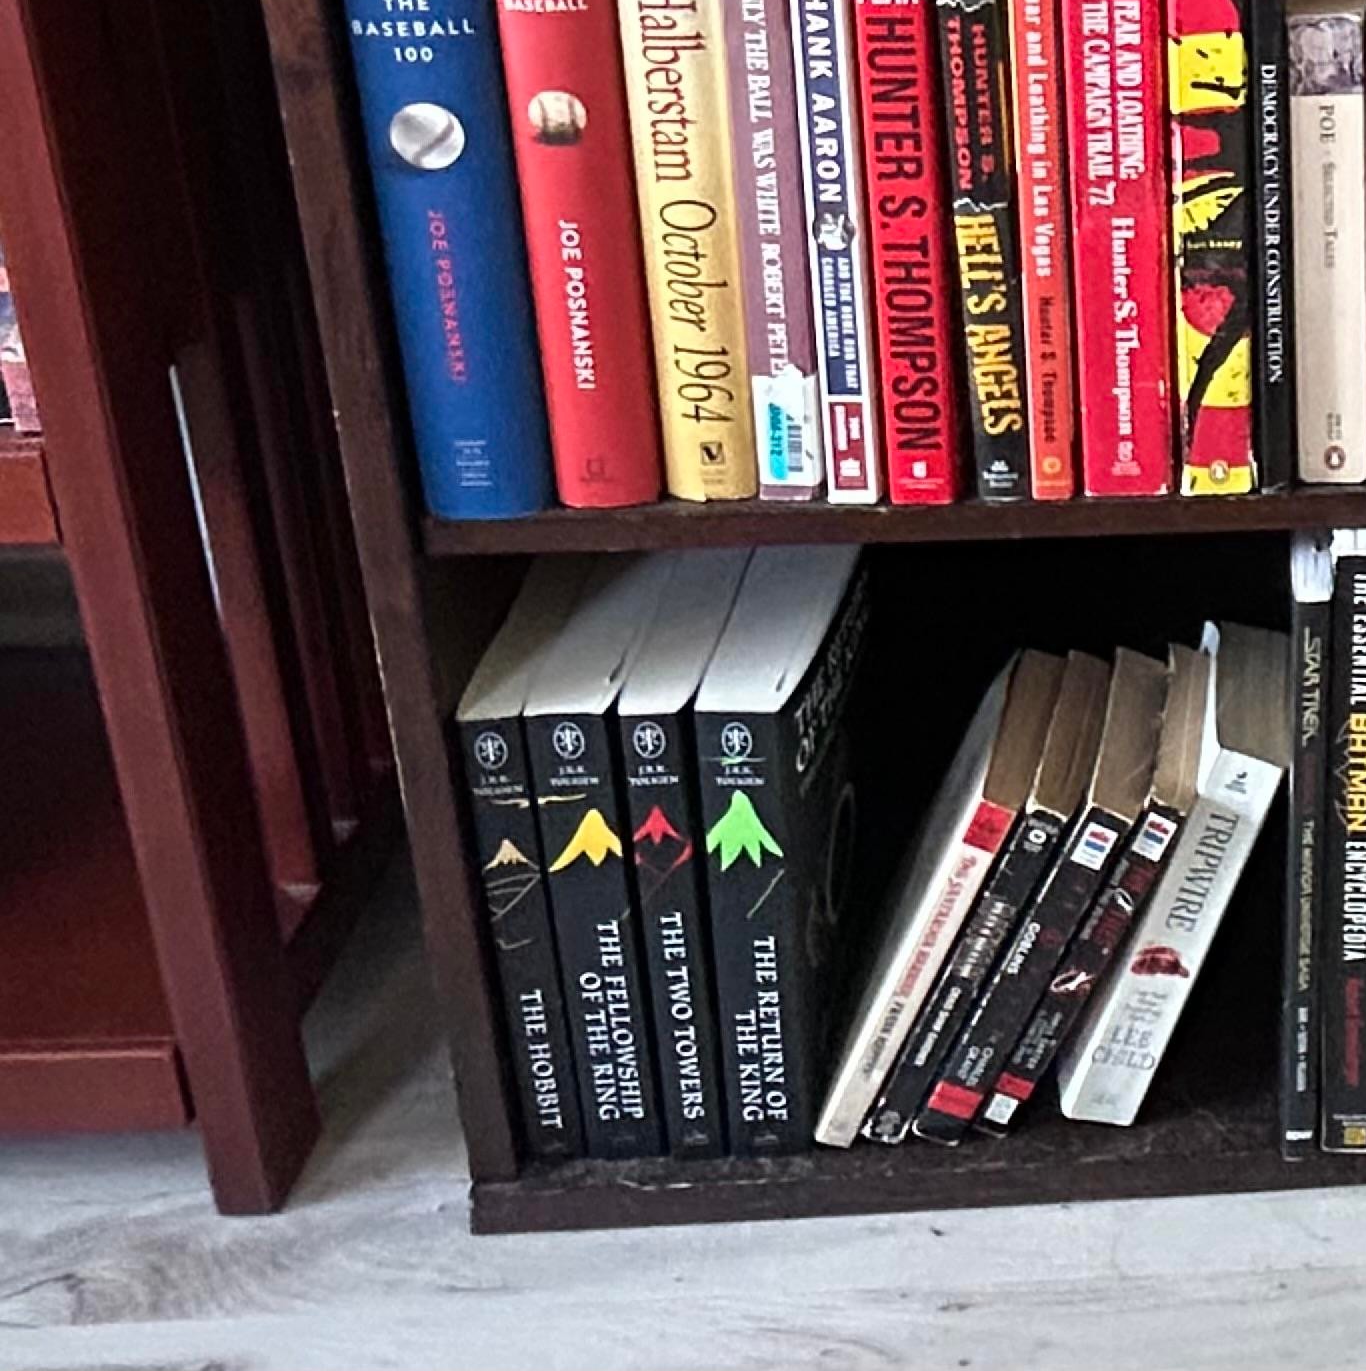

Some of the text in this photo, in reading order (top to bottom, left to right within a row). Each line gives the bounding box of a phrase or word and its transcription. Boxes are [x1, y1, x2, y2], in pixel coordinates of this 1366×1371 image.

[350, 18, 475, 38] BASEBALL
[393, 46, 434, 63] 100
[743, 29, 770, 72] THE
[1026, 31, 1049, 68] and
[1082, 0, 1109, 37] THE
[747, 73, 774, 124] BALL
[947, 16, 974, 191] THOMPSON
[970, 23, 994, 146] HUNTER
[1083, 39, 1115, 129] CAMPAIGN
[1115, 51, 1143, 88] AND
[751, 127, 778, 172] WAS
[810, 91, 842, 203] AARON
[1028, 73, 1050, 156] Loathing
[1087, 130, 1114, 181] TRAIL
[1318, 104, 1337, 145] POE
[755, 169, 783, 237] WHITE
[1031, 160, 1048, 180] in
[1033, 185, 1053, 217] Las
[659, 199, 729, 334] October
[865, 16, 943, 452] HUNTER S. THOMPSON
[1031, 222, 1056, 277] Vegas
[1260, 63, 1284, 385] DEMOCRACY UNDER CONSTRUCTION
[426, 208, 468, 385] JOE POSNANSKI
[557, 218, 597, 391] JOE POSNANSKI
[760, 243, 787, 319] ROBERT
[953, 213, 1023, 437] HELL'S ANGELS
[1111, 216, 1141, 435] Hunter Thompson
[672, 345, 736, 425] 1964
[1301, 626, 1322, 748] STAR TREK
[1165, 812, 1239, 934] TRIPWIRE
[519, 988, 564, 1130] THE HOBBIT
[578, 971, 622, 1122] OF THE RING
[596, 919, 645, 1121] THE FELLOWSHIP
[659, 911, 706, 1121] THE TWO TOWERS
[753, 934, 789, 1122] THE RETURN OF
[1091, 1044, 1156, 1072] CHILD
[1110, 1028, 1153, 1049] LEE
[735, 1008, 766, 1123] THE KING
